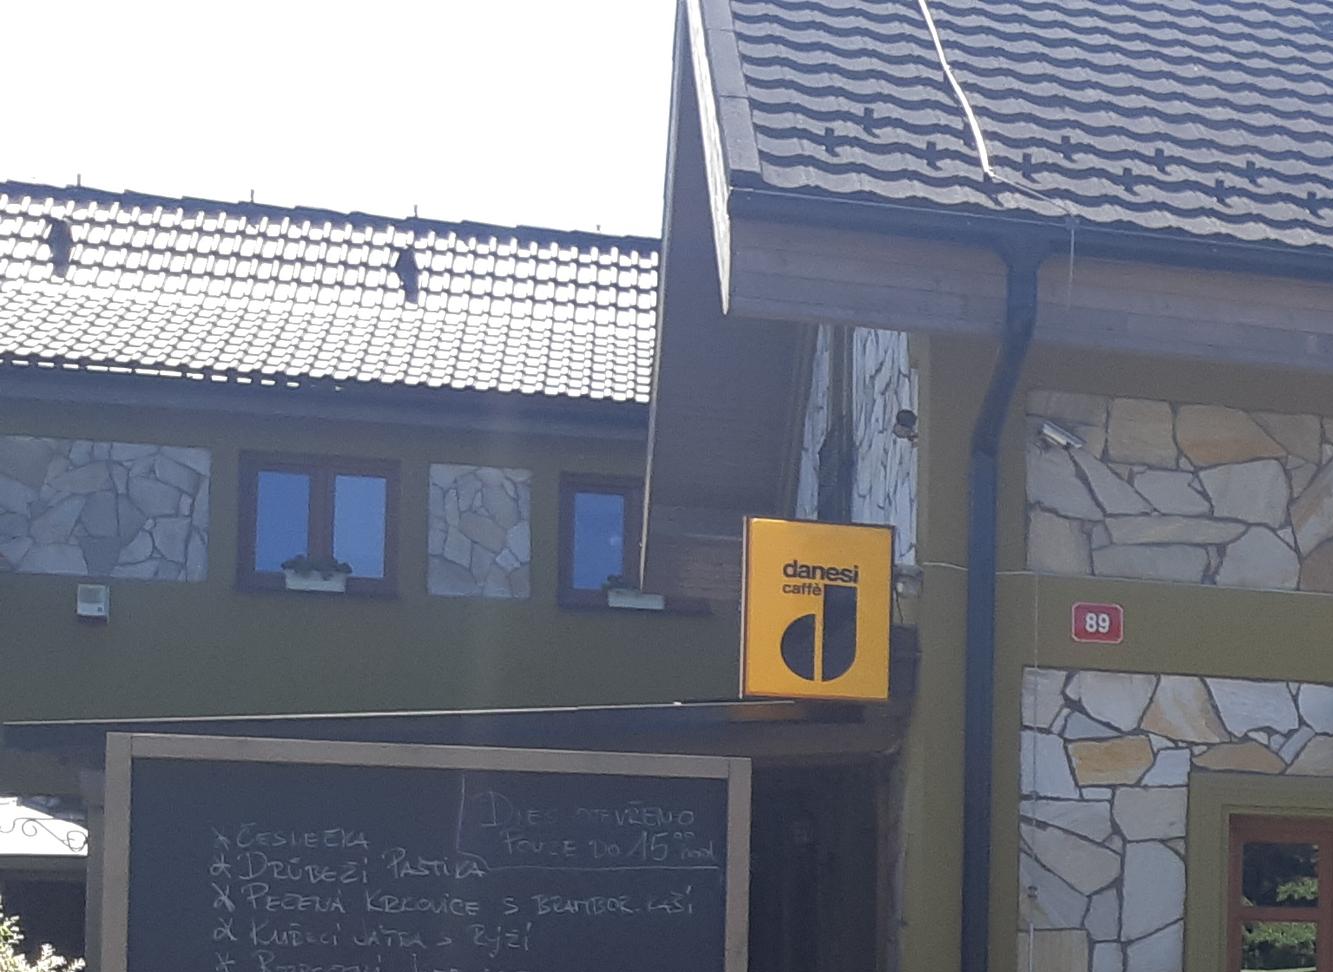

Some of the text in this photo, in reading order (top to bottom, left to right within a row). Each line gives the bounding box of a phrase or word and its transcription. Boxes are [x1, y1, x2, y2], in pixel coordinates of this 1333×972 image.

[783, 559, 859, 584] danesi
[782, 582, 823, 597] caffè
[1084, 612, 1110, 633] 89
